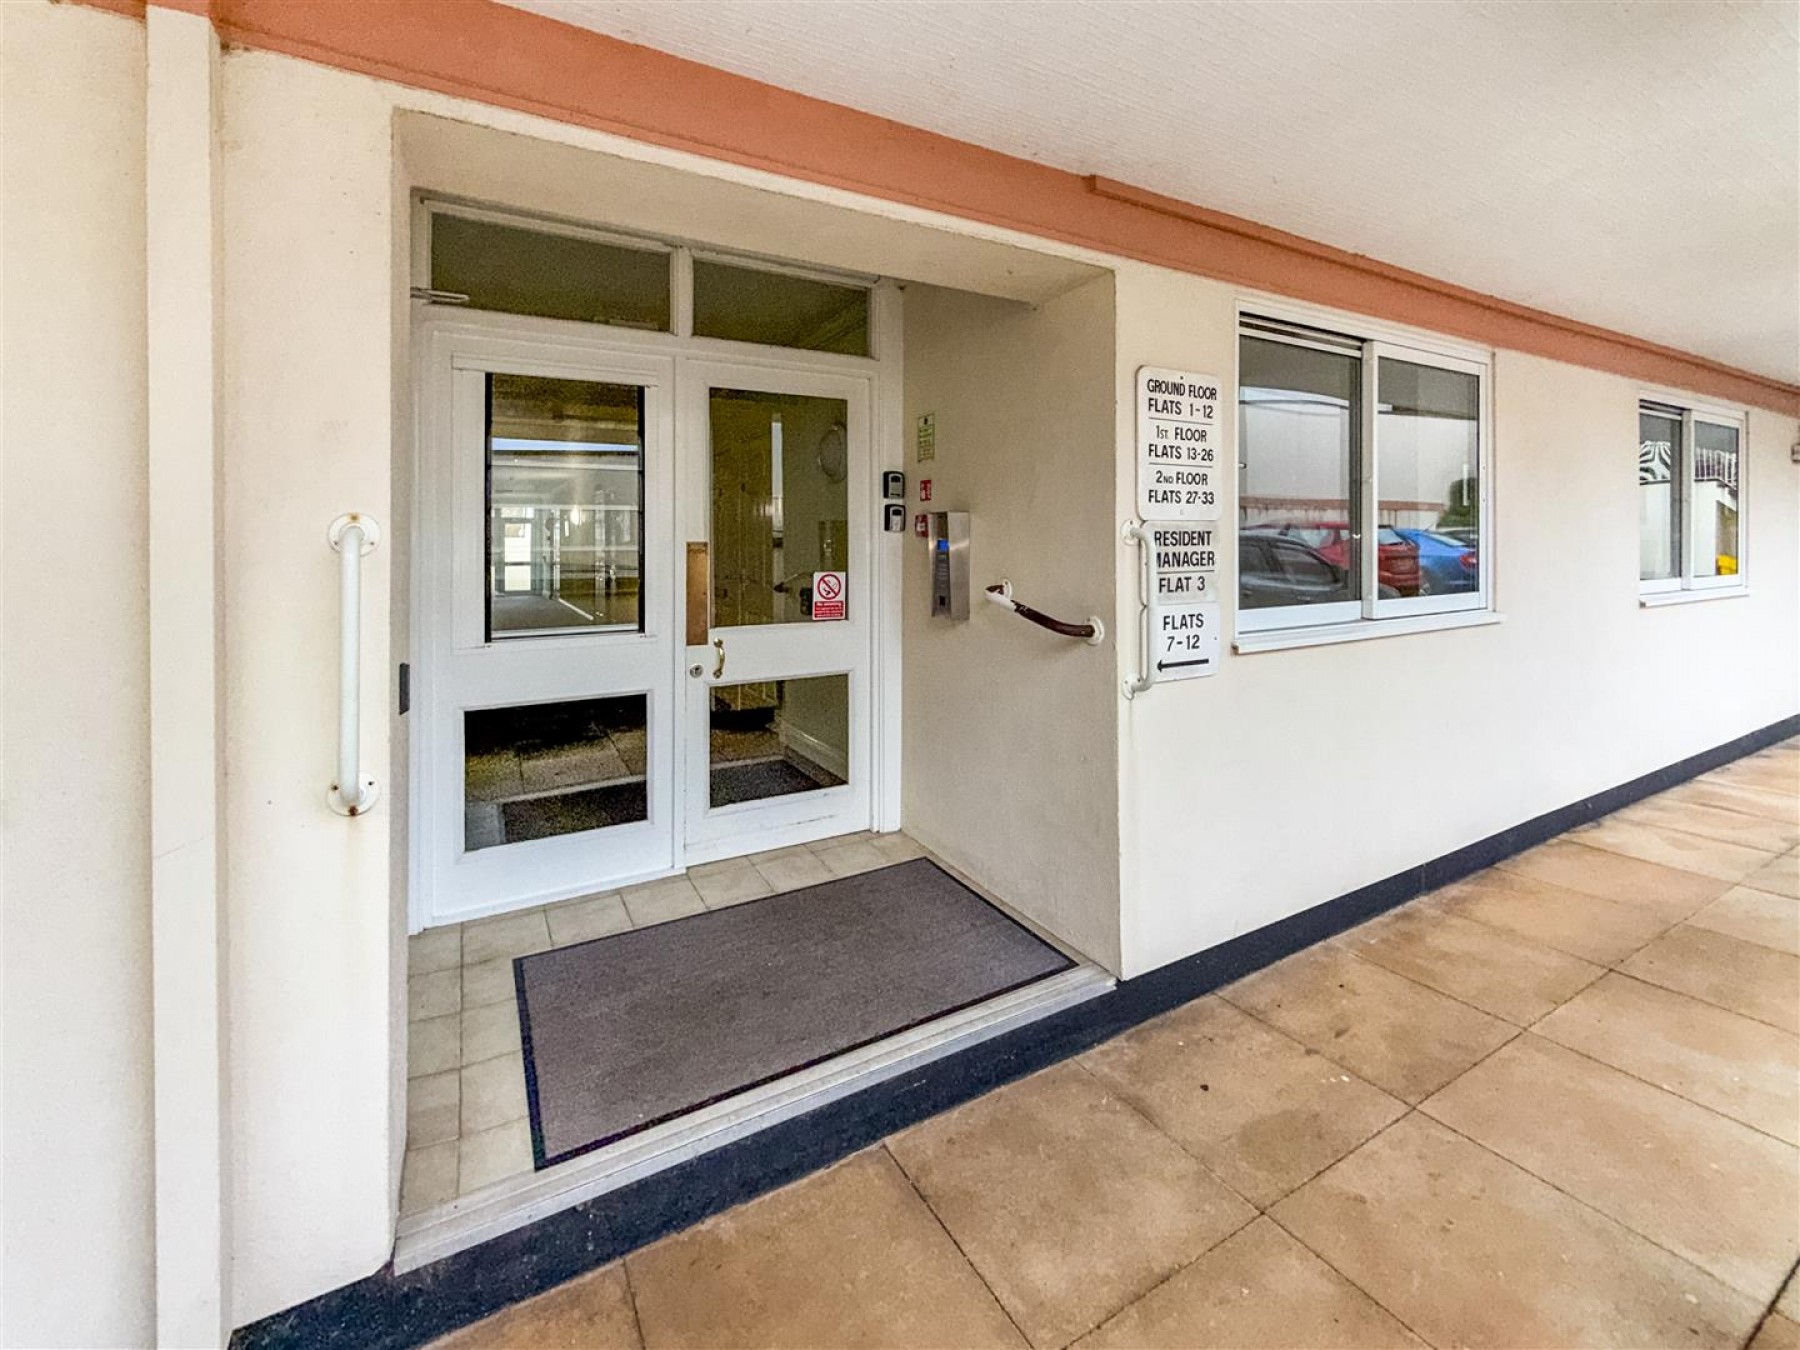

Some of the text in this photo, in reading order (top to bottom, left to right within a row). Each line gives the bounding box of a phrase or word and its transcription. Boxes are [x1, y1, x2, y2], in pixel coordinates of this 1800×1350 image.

[1147, 379, 1216, 400] GROUND FLOOR
[1148, 398, 1213, 418] FLATS 1-12
[1174, 427, 1206, 442] FLOOR
[1148, 444, 1214, 462] FLATS 13-26
[1156, 470, 1208, 486] 2ND FLOOR
[1148, 490, 1214, 505] FLATS 27-33
[1154, 530, 1212, 546] RESIDENT
[1159, 576, 1206, 593] FLAT 3
[1163, 614, 1204, 630] FLATS
[1167, 634, 1200, 652] 7-12
